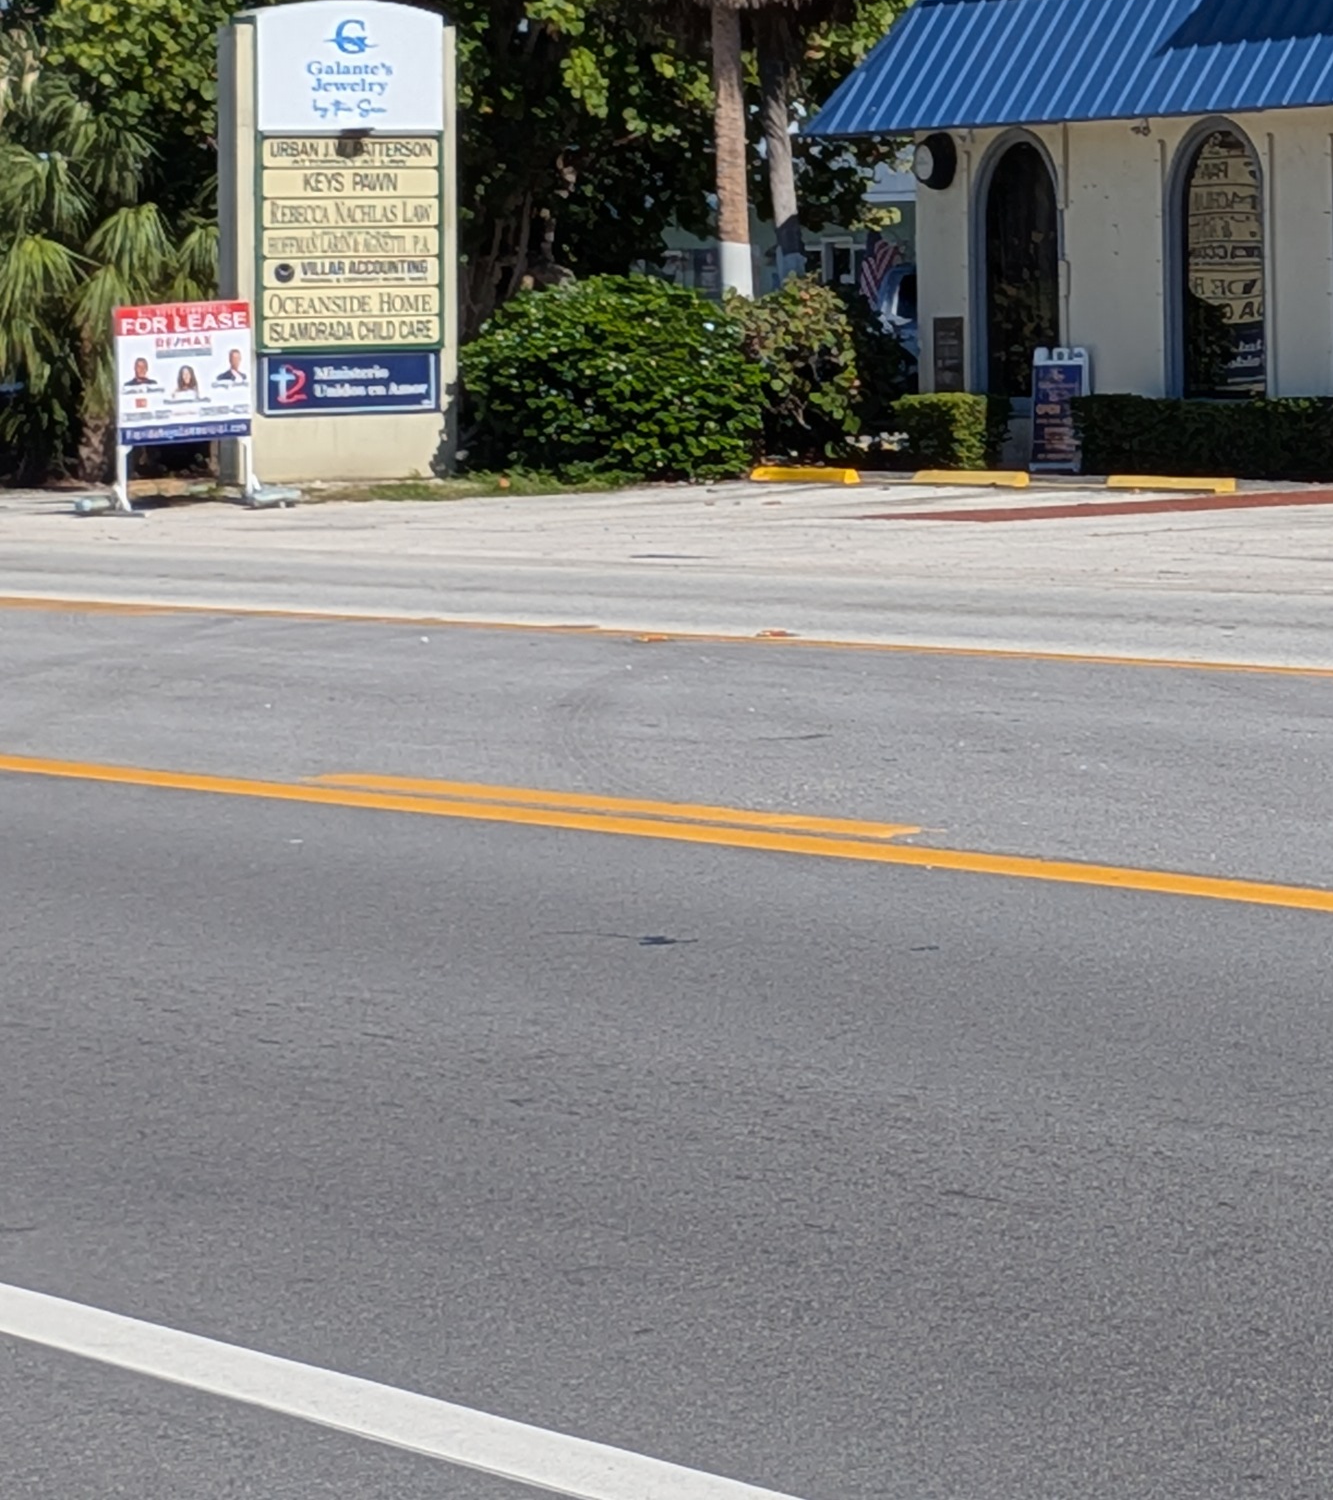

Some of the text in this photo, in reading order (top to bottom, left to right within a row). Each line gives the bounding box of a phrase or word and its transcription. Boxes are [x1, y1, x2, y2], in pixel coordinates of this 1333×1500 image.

[306, 61, 393, 76] Galante's
[311, 78, 389, 96] Jewelry
[270, 142, 319, 158] URBAN
[303, 173, 397, 192] KEYS PAWN
[270, 201, 329, 224] REBECCA
[402, 201, 432, 223] LAW
[350, 260, 428, 276] ACCOUNTING
[269, 292, 432, 316] OCEANSIDE HOME
[121, 317, 169, 335] FOR
[173, 311, 247, 333] LEASE
[269, 320, 433, 343] ISLAMORADA CHILD CARE
[313, 364, 390, 381] Ministerio
[313, 382, 428, 398] Unidos en Amor
